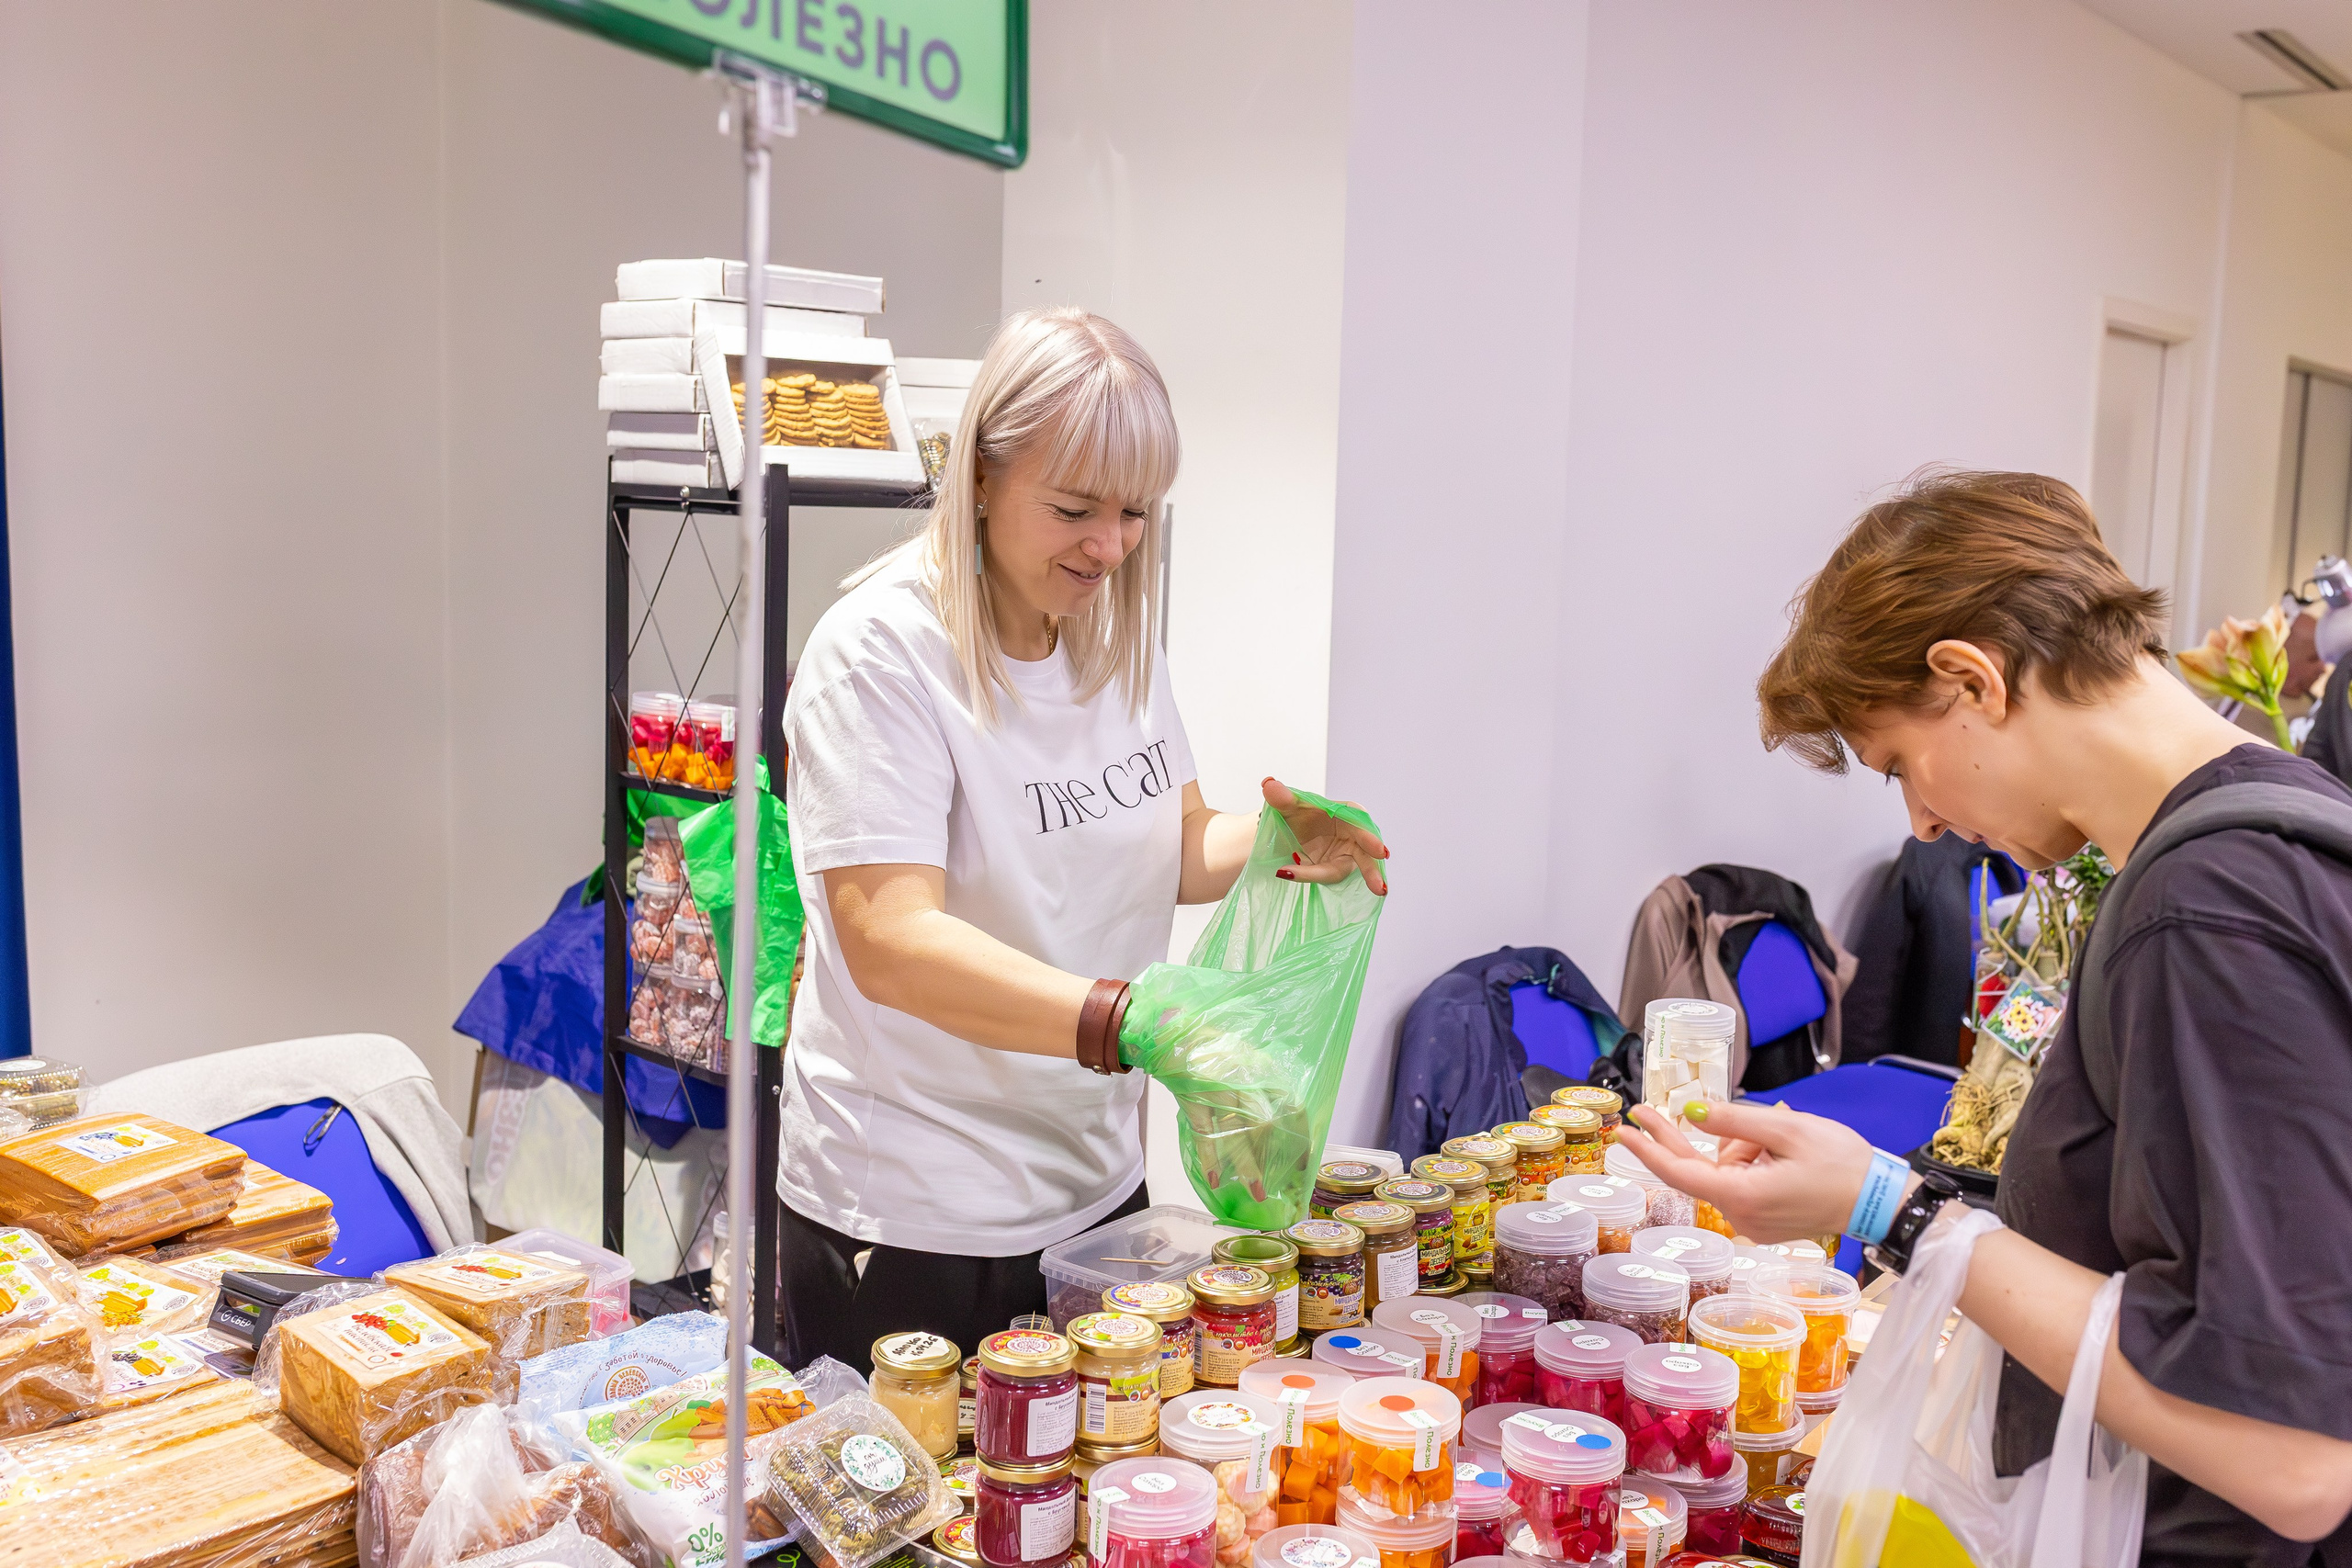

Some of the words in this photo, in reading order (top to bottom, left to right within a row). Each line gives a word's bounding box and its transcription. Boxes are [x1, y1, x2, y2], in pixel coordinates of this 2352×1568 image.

[231, 1314, 253, 1328] СБЕР
[605, 1349, 639, 1371] заботой
[1446, 1342, 1457, 1376] Полезно
[1285, 1408, 1295, 1445] Полезно
[1424, 1431, 1434, 1469] Полезно
[1255, 1451, 1266, 1489] Полезно
[1643, 1509, 1662, 1525] Вкусно
[687, 1522, 724, 1553] 0%
